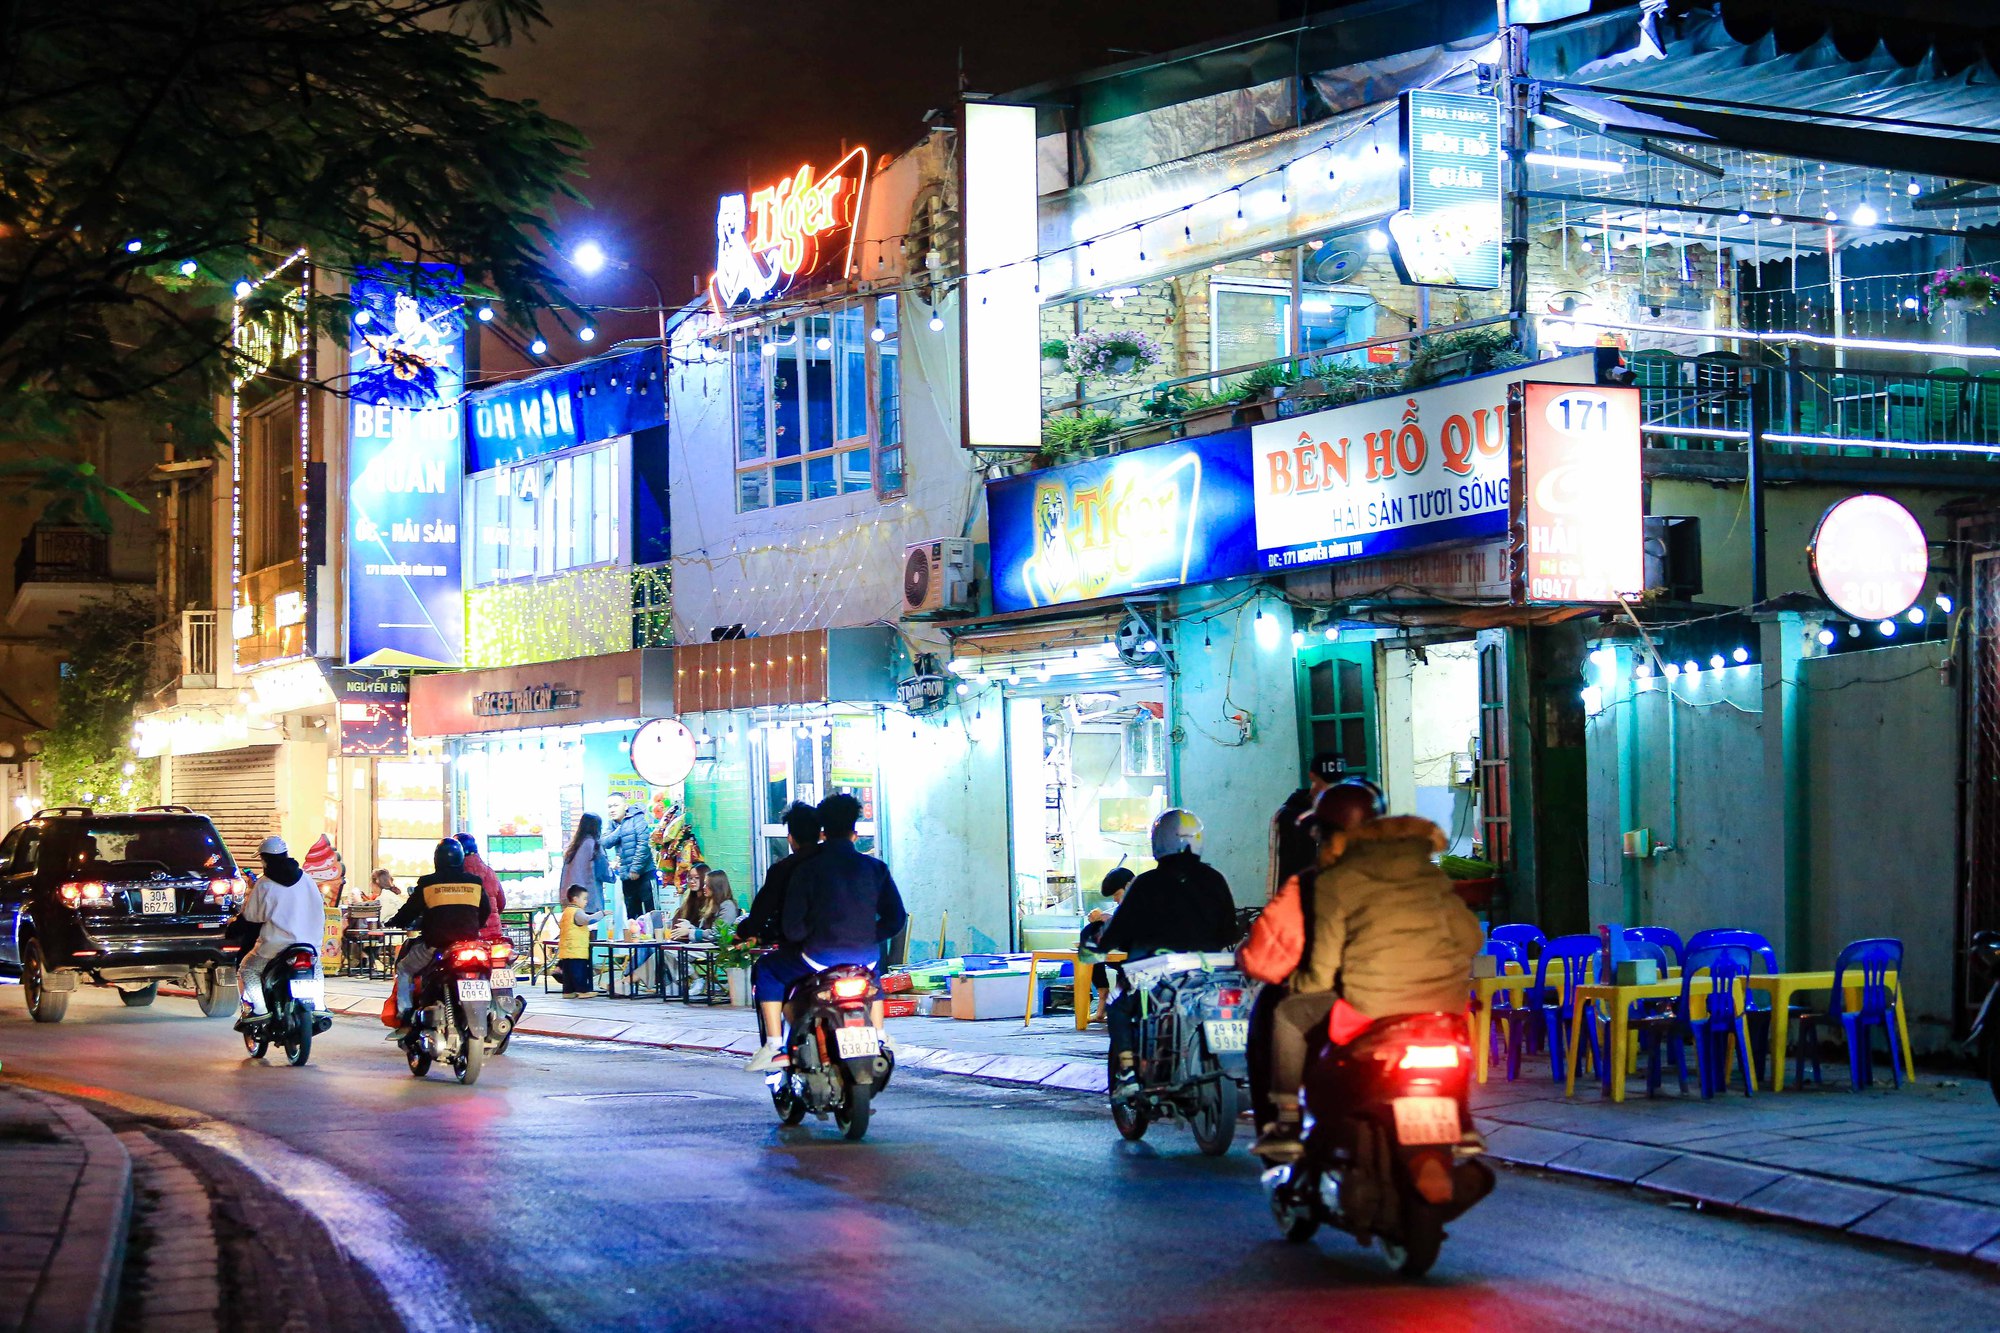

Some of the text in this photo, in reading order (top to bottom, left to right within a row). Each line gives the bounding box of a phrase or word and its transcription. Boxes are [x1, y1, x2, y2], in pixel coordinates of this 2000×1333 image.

[750, 164, 842, 274] Tiger
[1559, 398, 1608, 432] 171
[1267, 431, 1350, 497] BÊN
[1363, 398, 1426, 481] HỒ
[1368, 493, 1403, 528] SẢN
[1408, 487, 1452, 521] TƯƠI
[1458, 474, 1509, 512] SỐNG
[1283, 550, 1297, 565] 171
[896, 681, 945, 703] STRONGBOW
